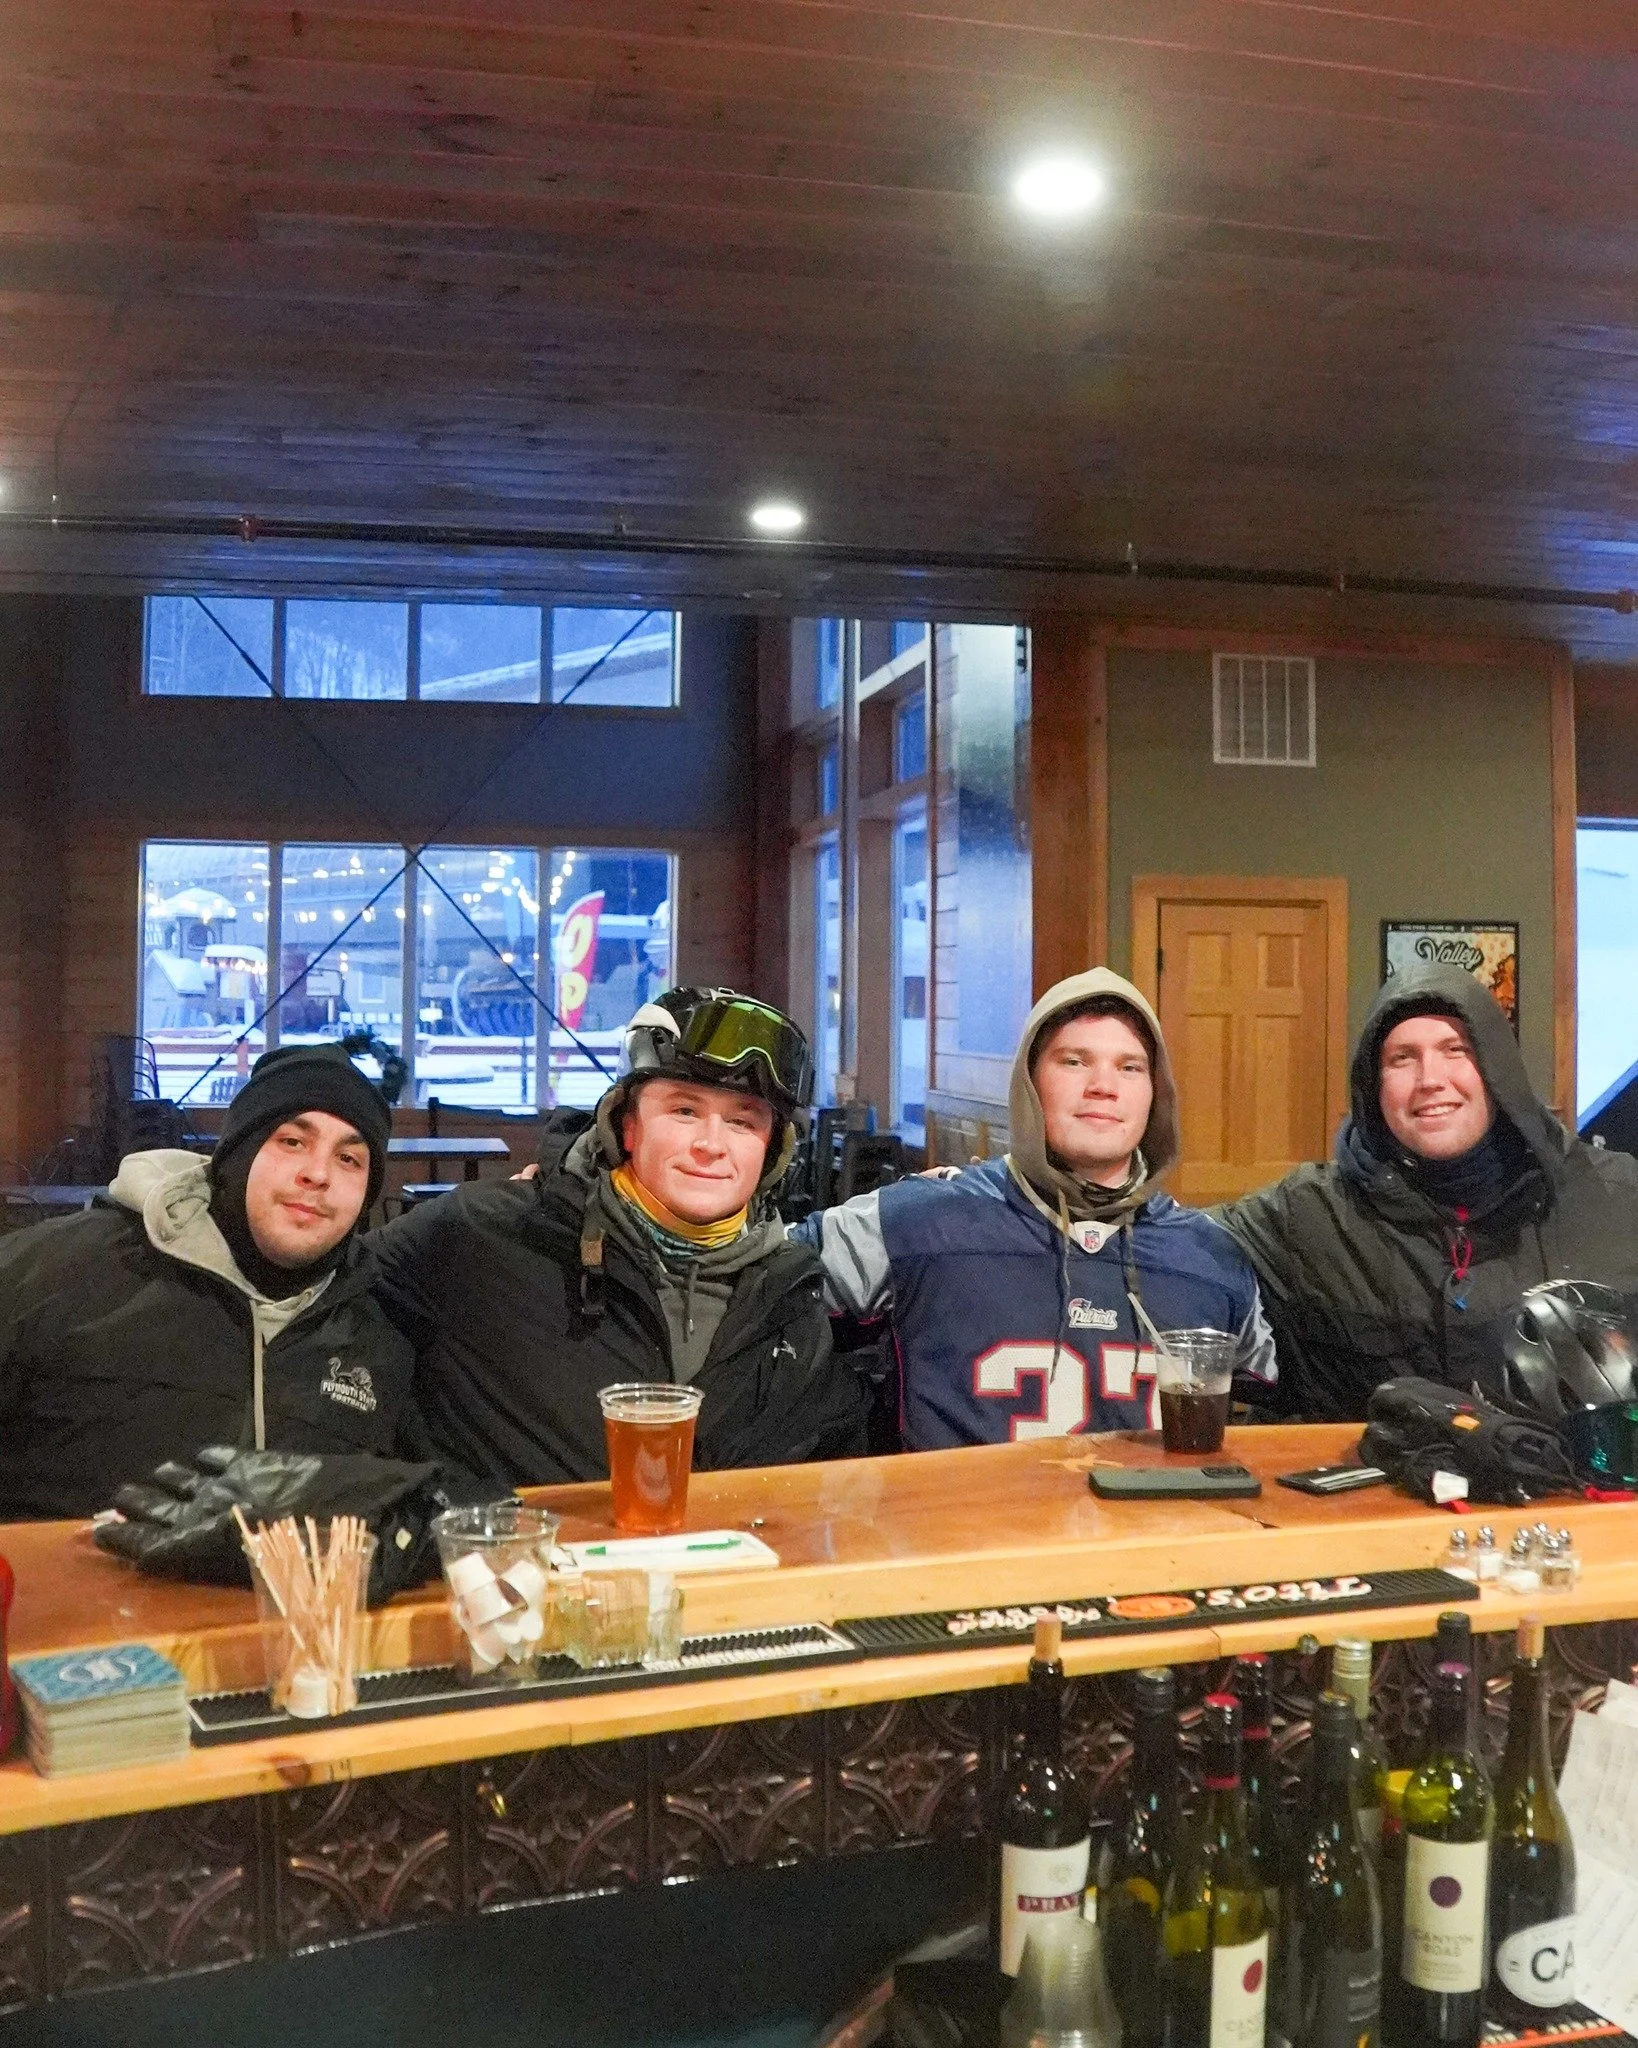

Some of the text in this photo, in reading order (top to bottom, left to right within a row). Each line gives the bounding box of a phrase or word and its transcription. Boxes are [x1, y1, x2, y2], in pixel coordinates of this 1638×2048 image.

[1415, 937, 1484, 973] Valley
[973, 1339, 1166, 1443] 37
[1204, 1575, 1373, 1610] Tito's
